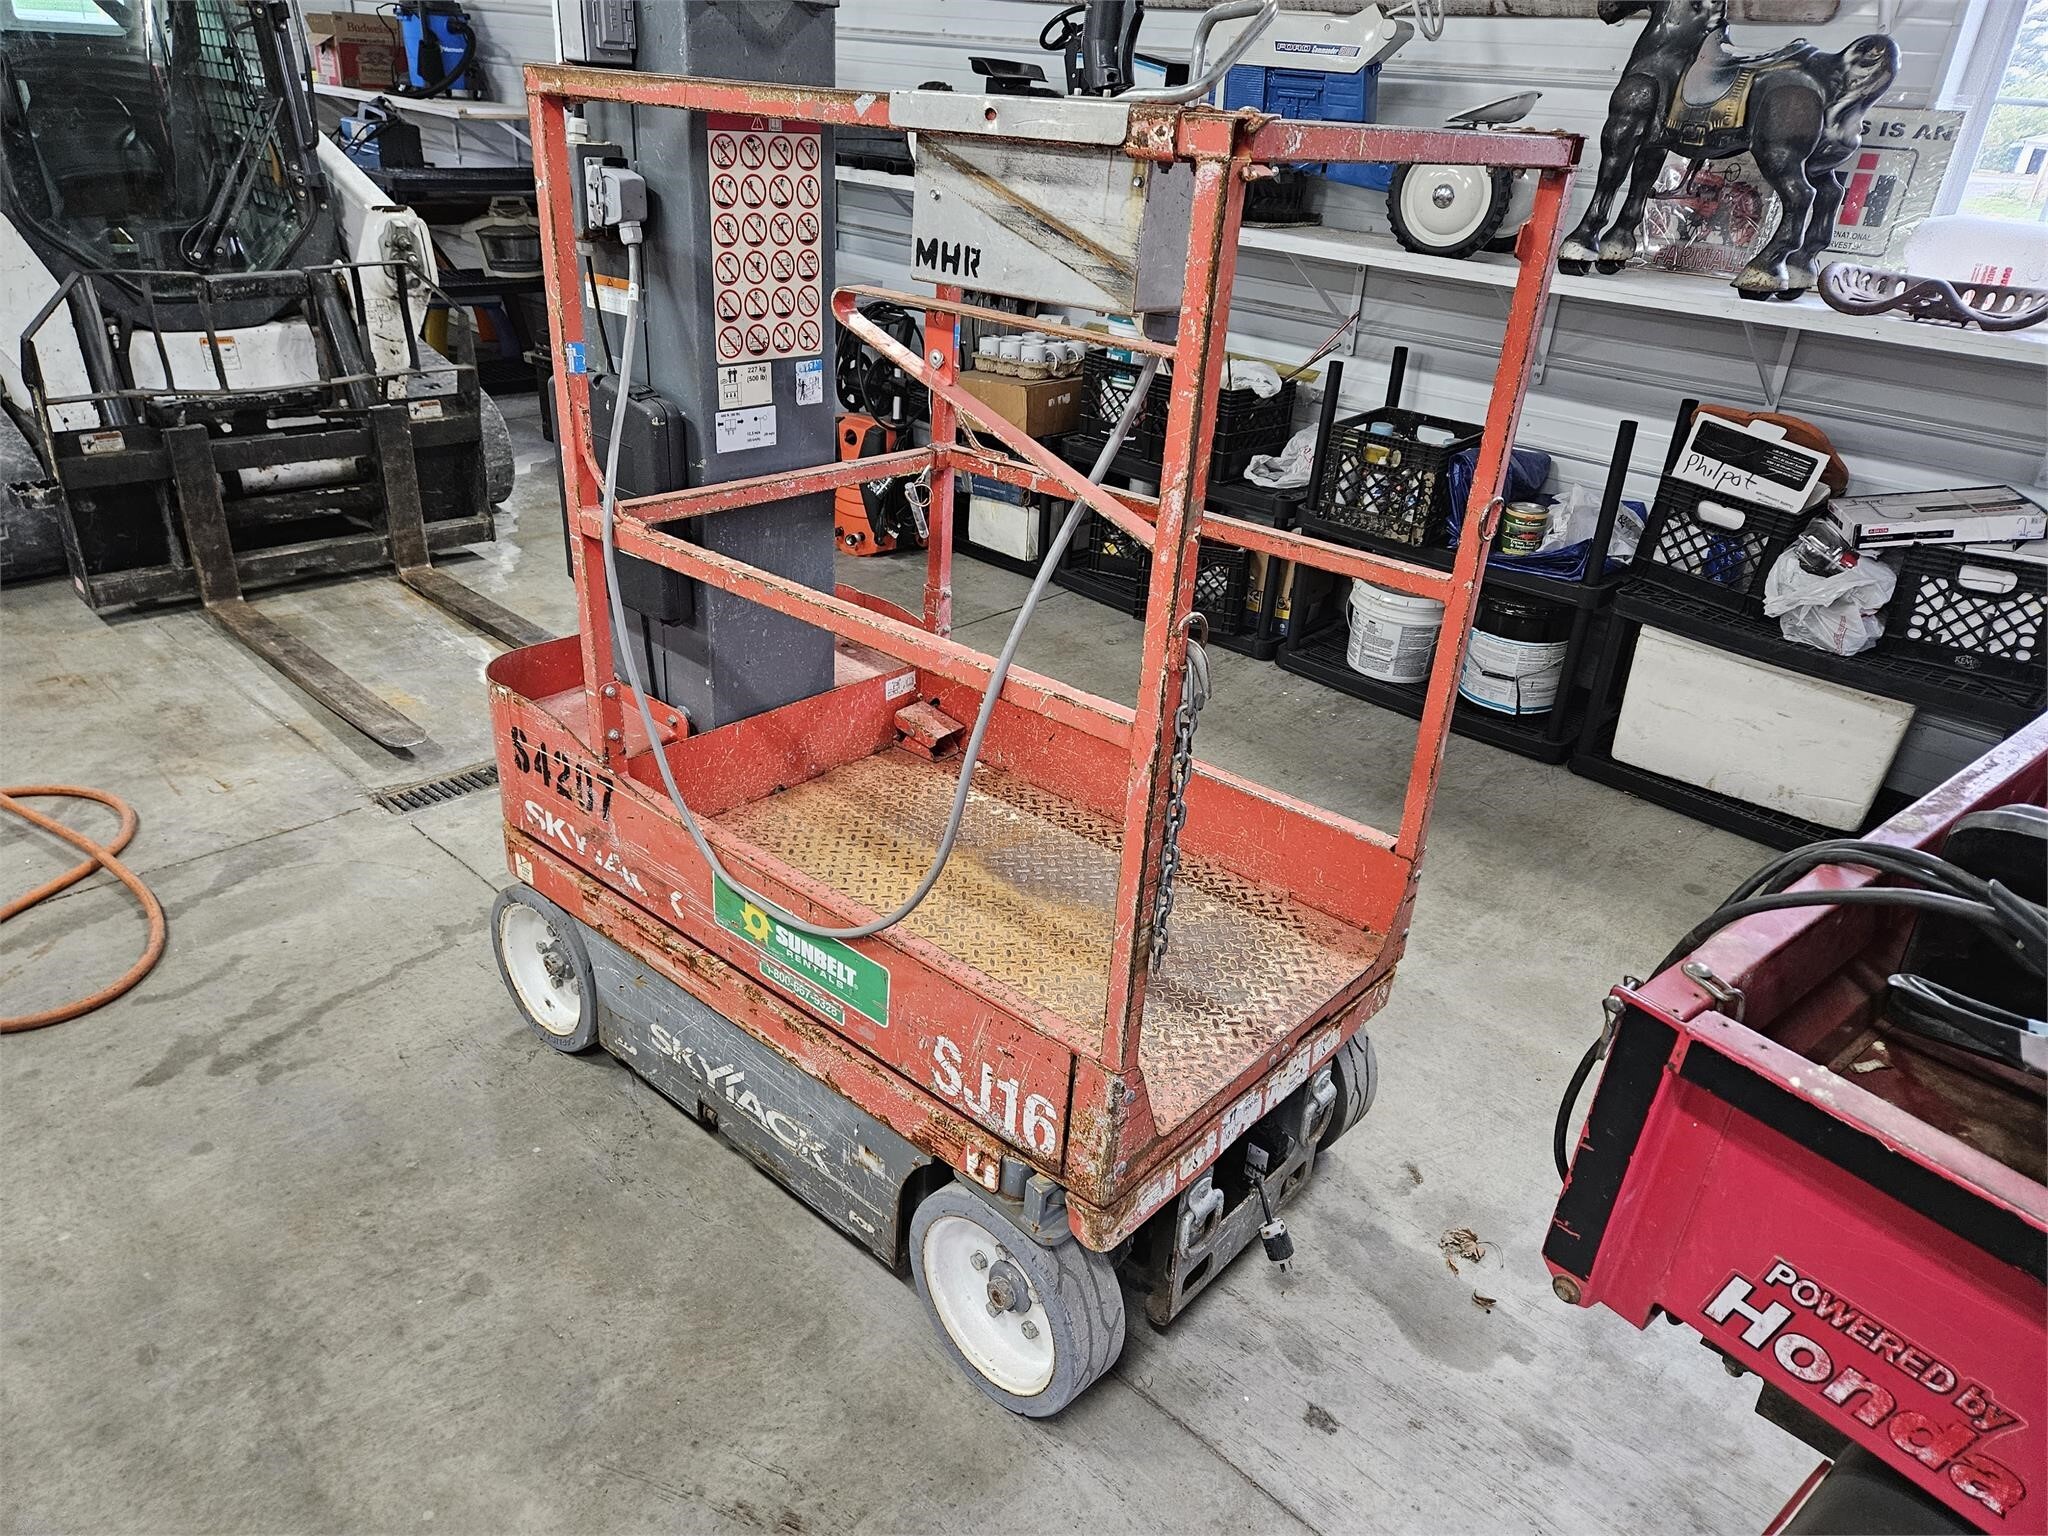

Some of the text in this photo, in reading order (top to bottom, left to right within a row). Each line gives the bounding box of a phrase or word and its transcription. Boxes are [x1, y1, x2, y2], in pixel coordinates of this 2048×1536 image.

[1277, 43, 1311, 52] FORD
[1879, 122, 1906, 138] IS
[916, 237, 982, 279] MHR
[1652, 244, 1746, 272] FARMALL
[759, 365, 767, 373] kg
[775, 925, 857, 988] SUNBELT
[786, 949, 844, 990] RENTALS
[651, 1023, 831, 1175] SKYJACK
[931, 1035, 1058, 1156] SJ16
[1763, 1261, 2021, 1433] POWERED by
[1702, 1274, 2027, 1520] Honda
